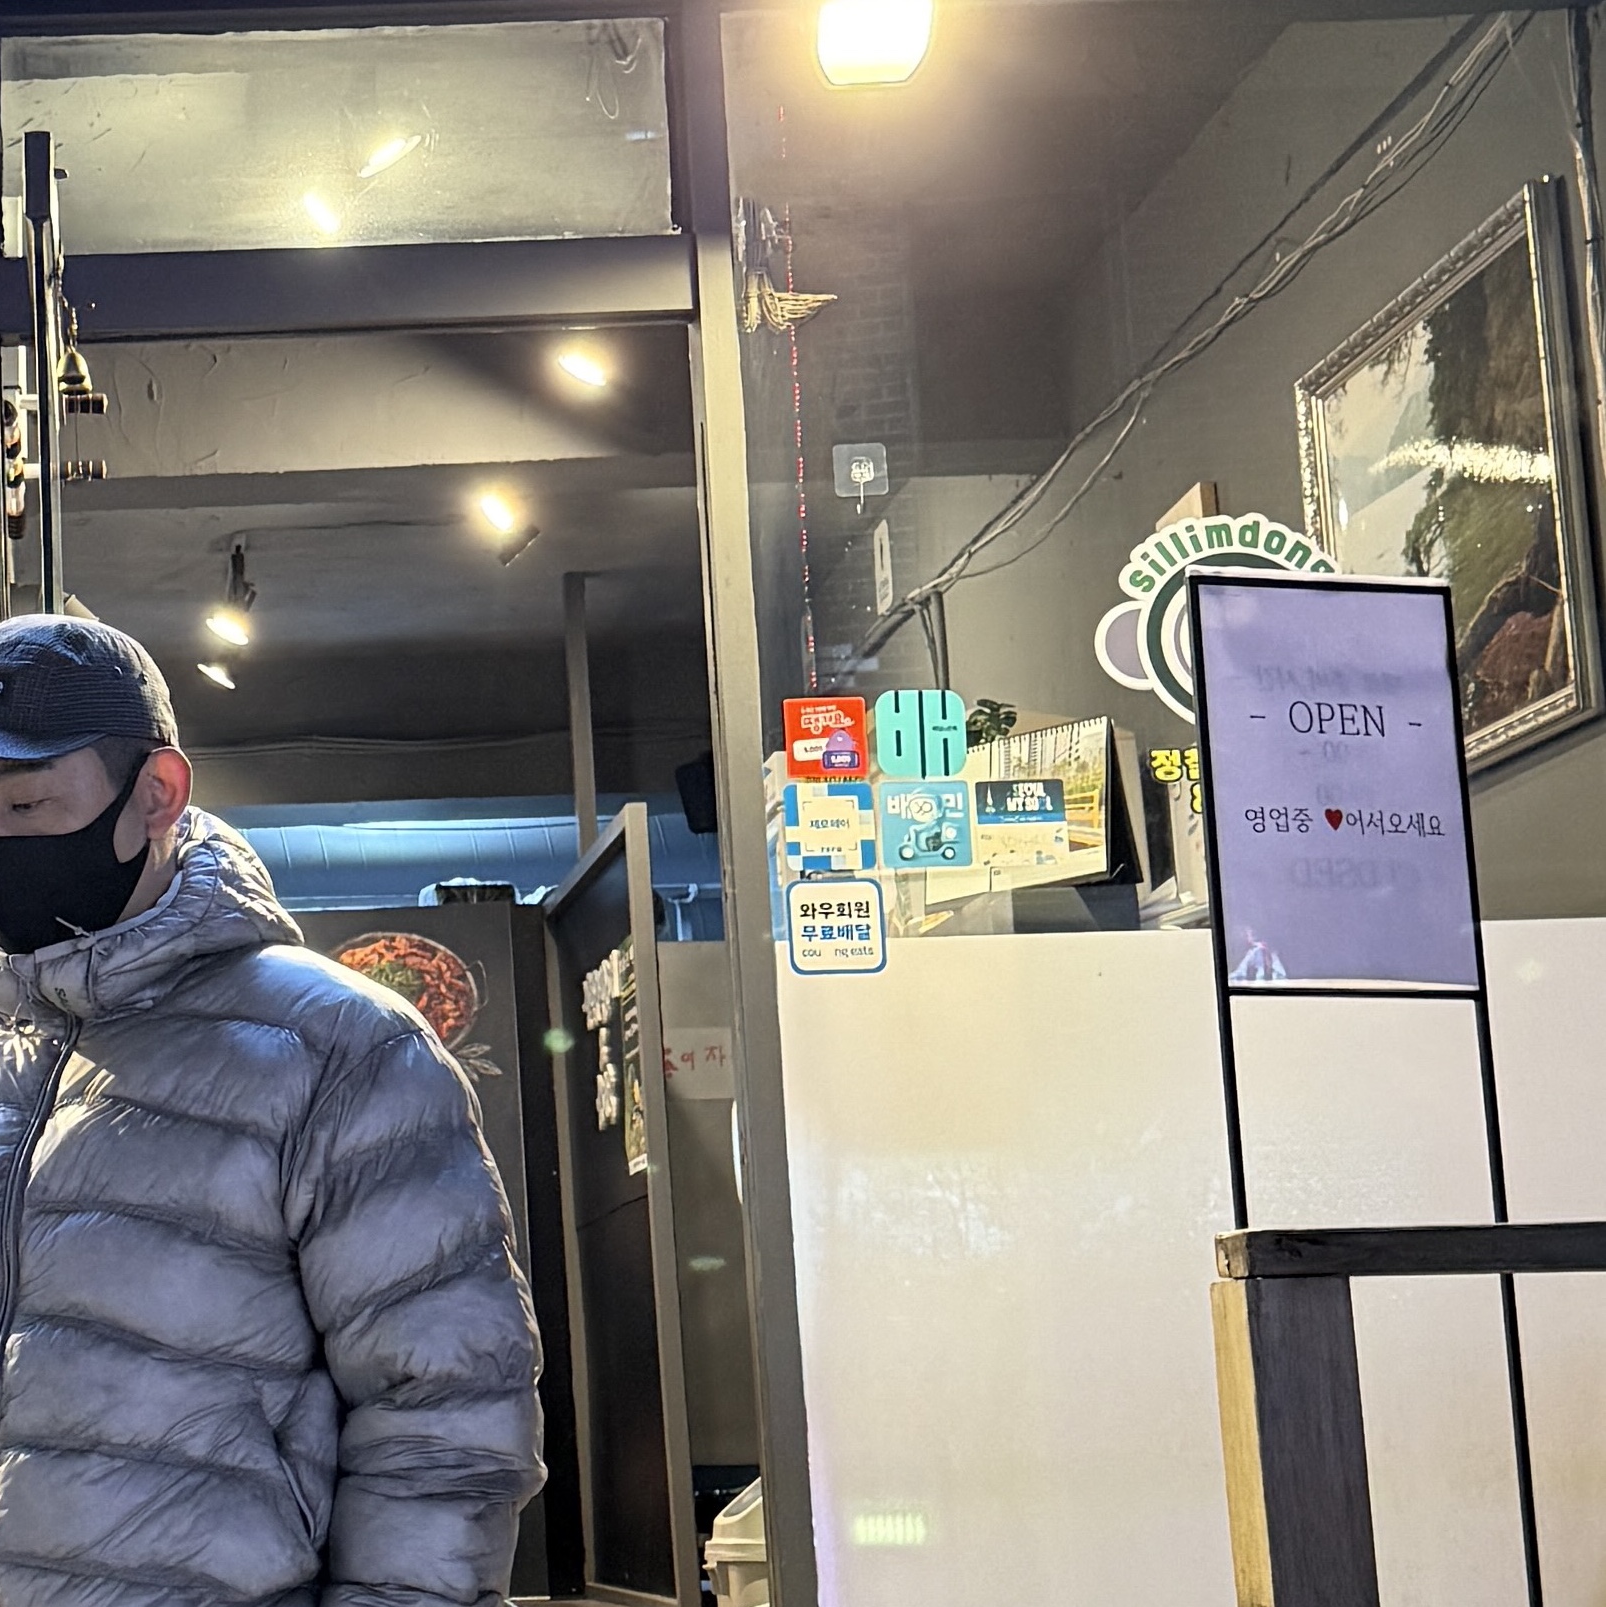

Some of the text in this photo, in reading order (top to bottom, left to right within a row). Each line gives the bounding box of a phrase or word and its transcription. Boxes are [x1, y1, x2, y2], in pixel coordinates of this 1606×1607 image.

[1289, 700, 1386, 738] OPEN
[1244, 806, 1446, 838] 영업중 어서오세요
[799, 900, 871, 920] 와우회원
[800, 923, 872, 942] 무료배달
[801, 946, 849, 959] coung
